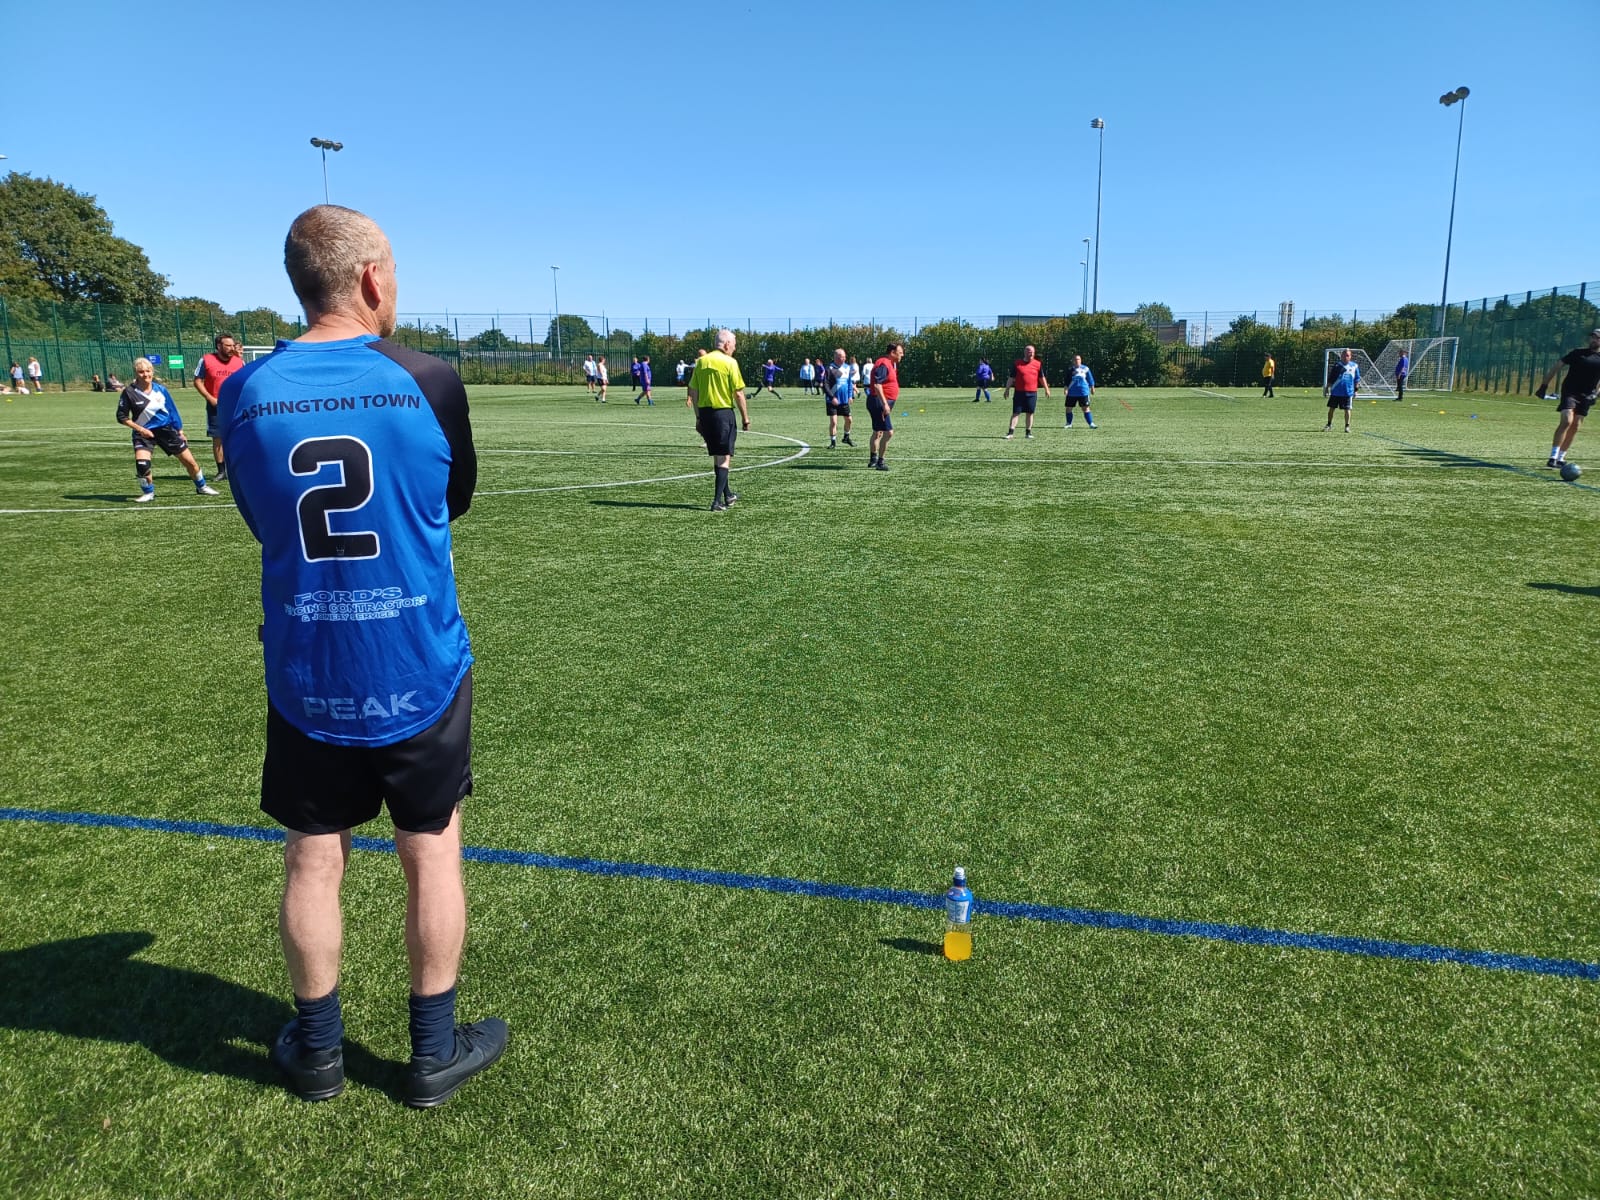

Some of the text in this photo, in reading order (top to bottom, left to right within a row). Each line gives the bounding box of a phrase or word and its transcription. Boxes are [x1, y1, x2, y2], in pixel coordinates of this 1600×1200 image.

[241, 393, 421, 421] ASHINGTON TOWN
[288, 435, 380, 563] 2
[294, 586, 403, 607] FORD'S
[328, 595, 428, 614] CONTRACTORS
[311, 612, 350, 622] JOINERY
[350, 609, 400, 621] SERVICES
[303, 689, 422, 720] PEAK
